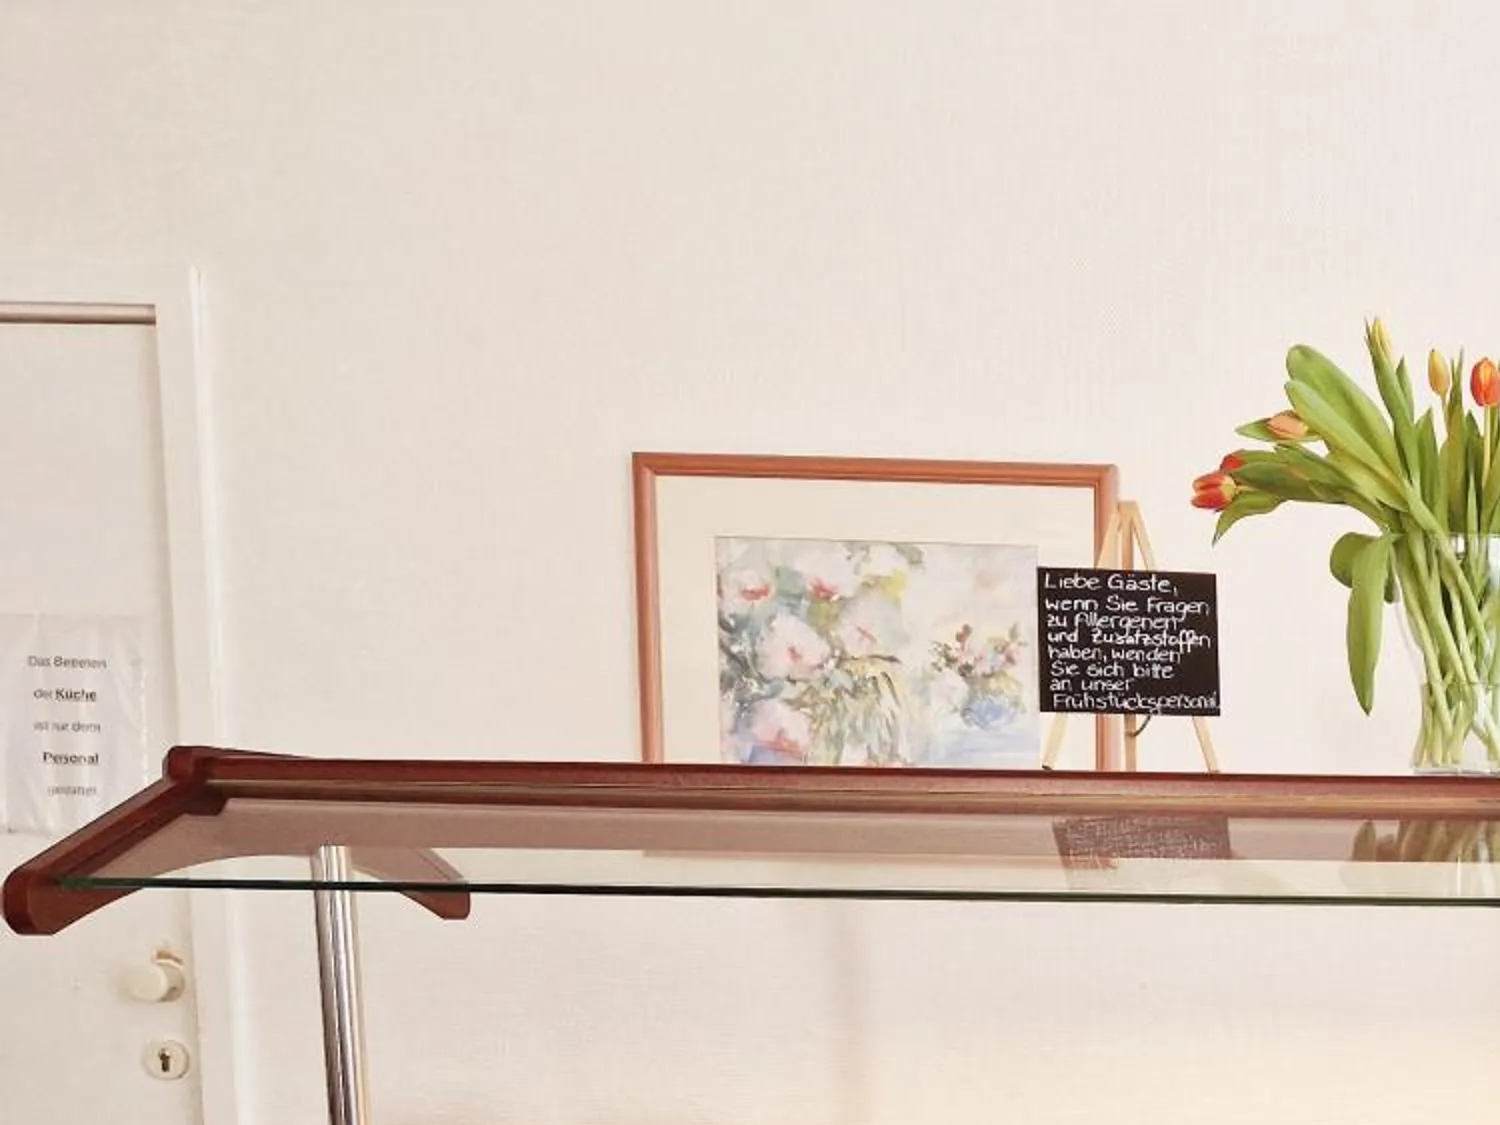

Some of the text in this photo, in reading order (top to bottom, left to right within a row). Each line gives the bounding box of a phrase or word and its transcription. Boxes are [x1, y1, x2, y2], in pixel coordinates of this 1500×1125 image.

[1044, 572, 1178, 596] Liebe Gäste,
[1045, 594, 1209, 621] wenn Sie Fragen
[1047, 612, 1178, 633] zu Allergenen
[1047, 628, 1211, 653] und Zusatzstoffen
[1048, 644, 1181, 664] haben, wenden
[1050, 660, 1174, 679] Sie sich bitte
[1050, 678, 1134, 692] an unser
